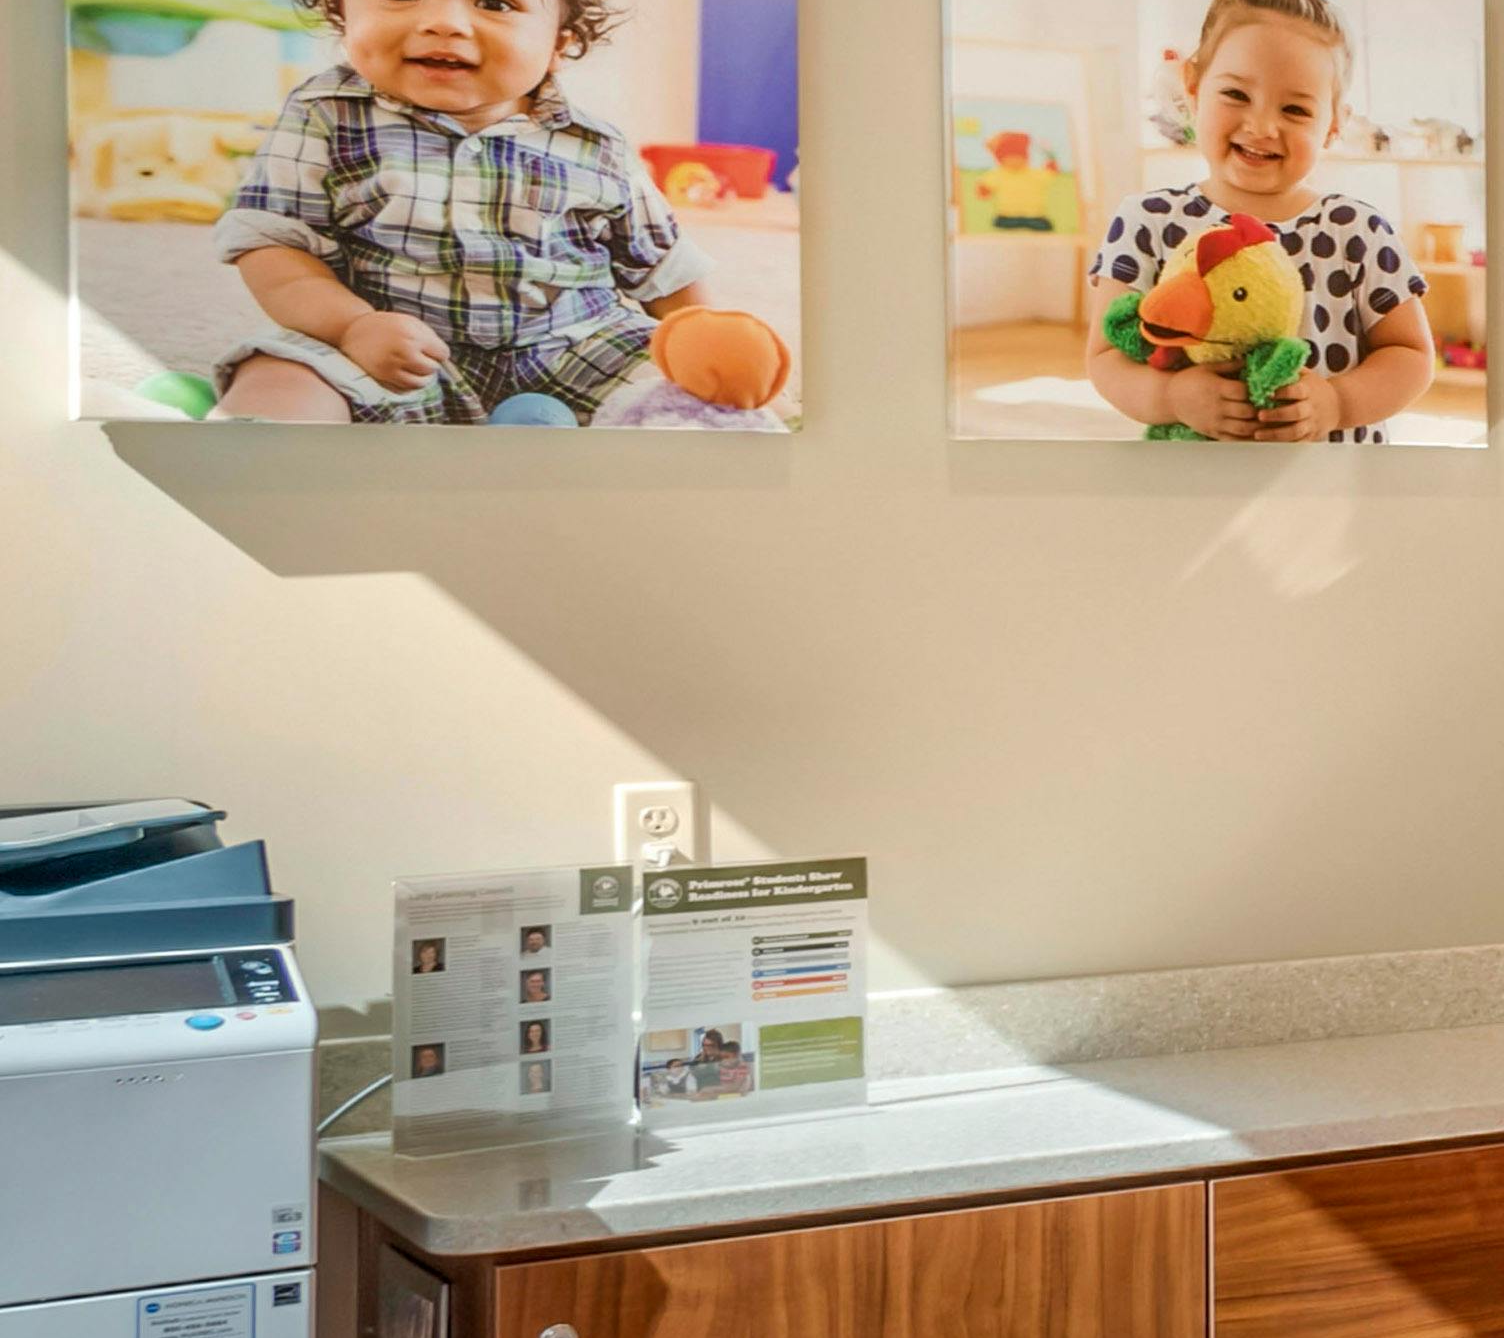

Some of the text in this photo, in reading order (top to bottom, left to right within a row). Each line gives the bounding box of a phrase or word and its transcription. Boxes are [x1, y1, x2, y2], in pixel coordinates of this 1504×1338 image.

[752, 873, 806, 886] Students
[808, 870, 844, 882] Show
[688, 881, 854, 903] Readiness for Kindergarten
